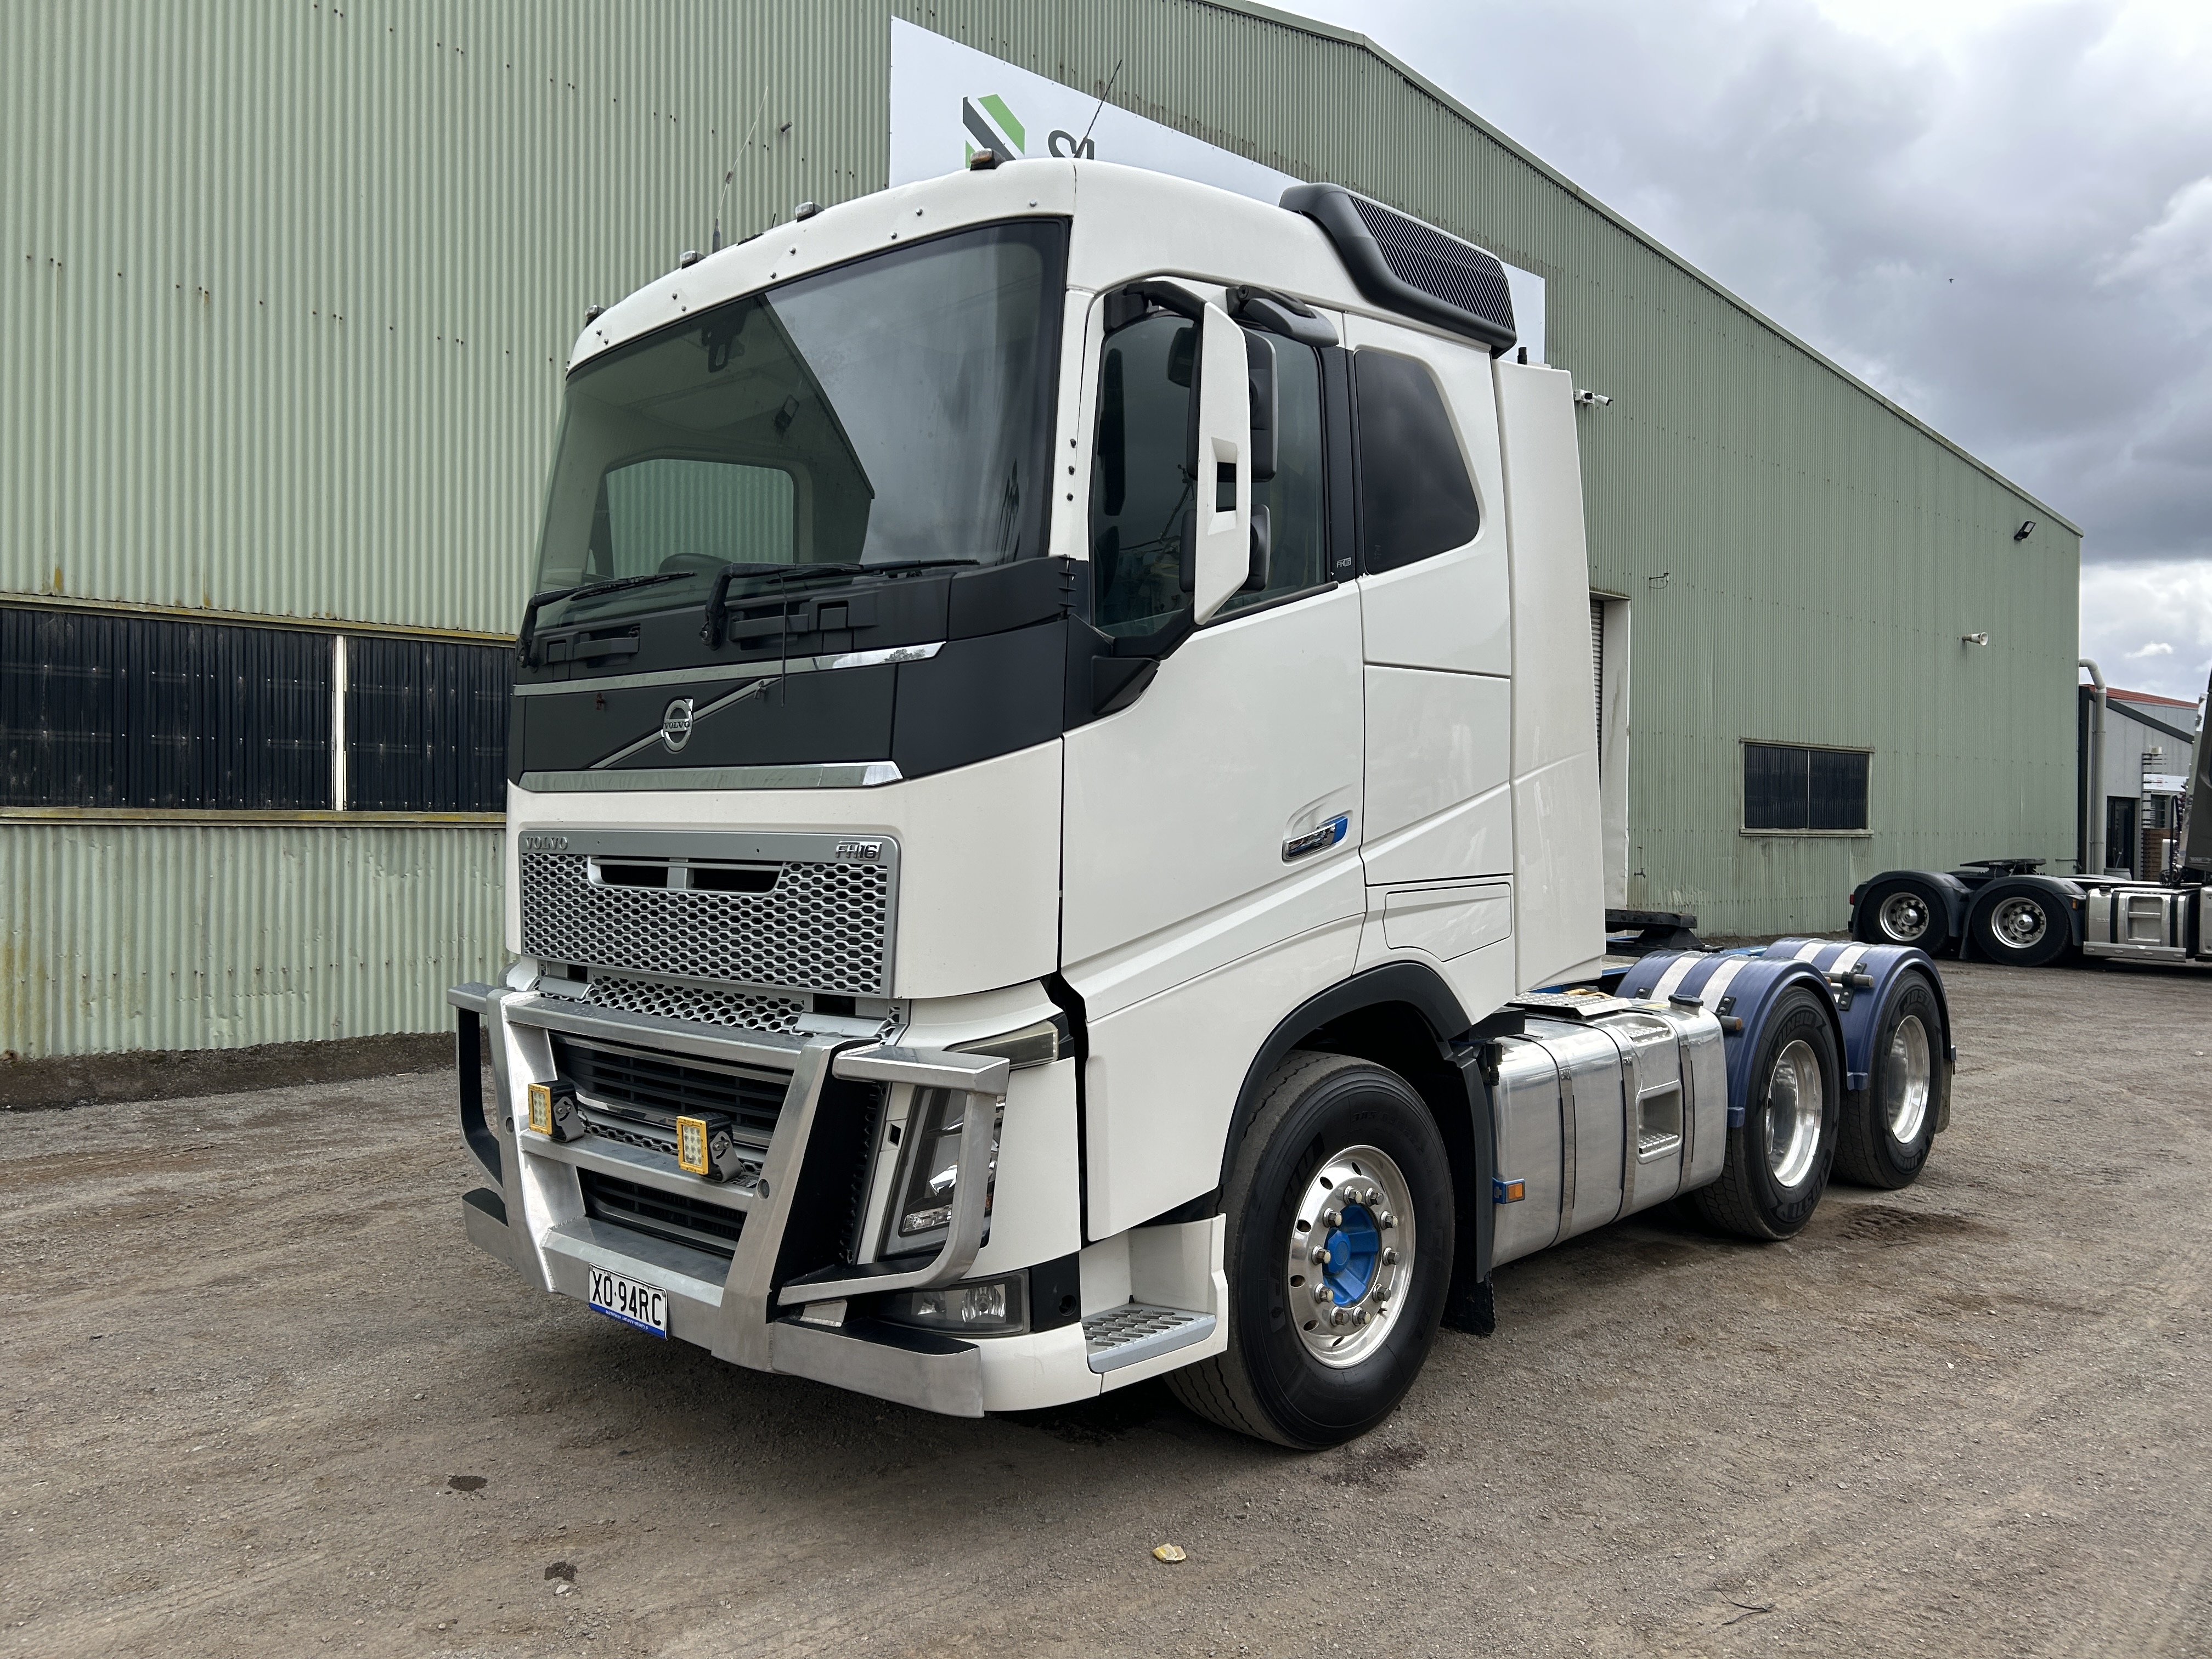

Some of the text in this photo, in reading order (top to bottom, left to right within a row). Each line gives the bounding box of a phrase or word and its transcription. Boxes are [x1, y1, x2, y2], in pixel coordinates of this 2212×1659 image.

[664, 721, 690, 729] VOLVO
[526, 836, 568, 850] VOLVO
[835, 843, 879, 859] FH16
[1775, 1012, 1814, 1056] JINYU
